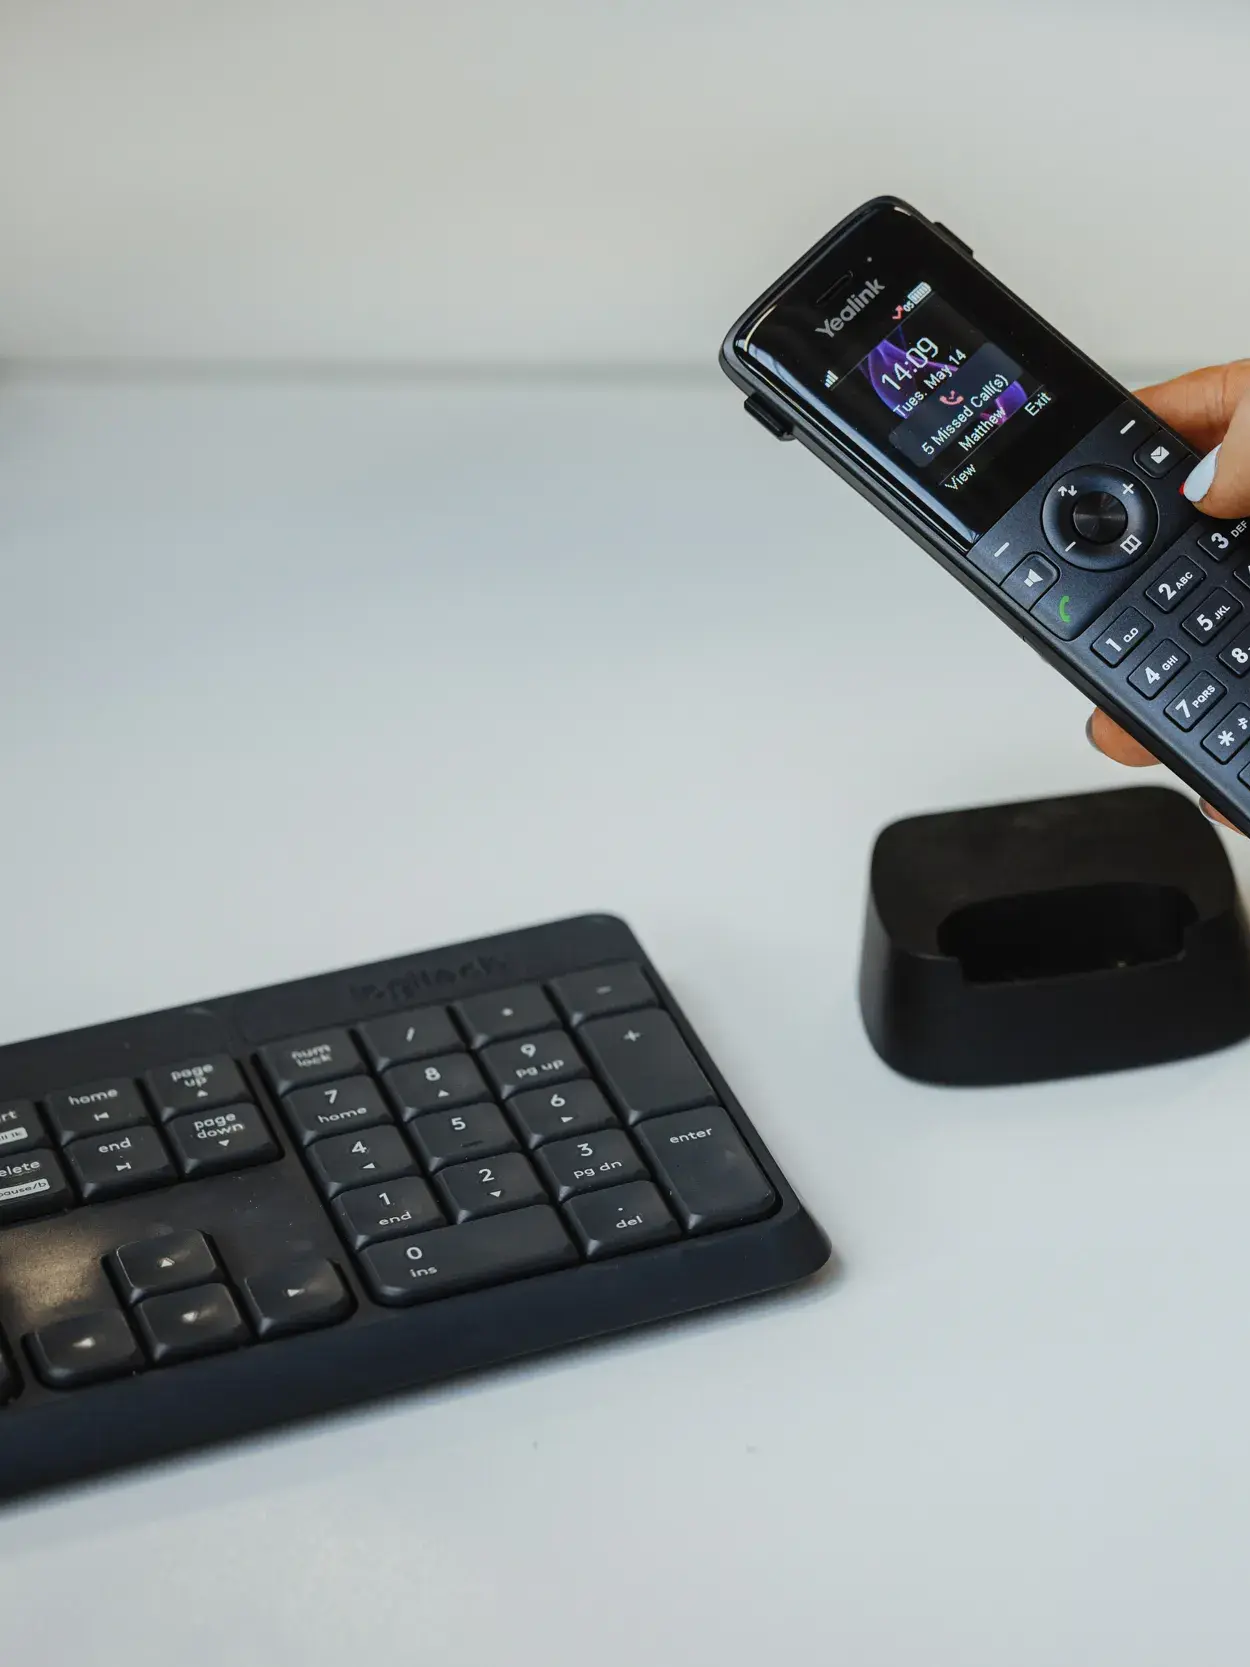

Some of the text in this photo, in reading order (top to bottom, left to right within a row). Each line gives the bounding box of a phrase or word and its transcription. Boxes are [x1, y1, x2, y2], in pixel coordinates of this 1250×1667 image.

[815, 278, 885, 338] Yealink
[881, 337, 939, 391] 14:09
[892, 348, 967, 419] Tues. May 14
[921, 373, 1010, 456] 5 Missed Call(s)
[958, 406, 1007, 451] Matthew
[945, 391, 1052, 491] View Exit
[1211, 520, 1249, 550] 3 DEF
[1158, 571, 1193, 600] 2 ABC
[1196, 605, 1231, 631] 5 JKL
[1105, 637, 1122, 652] 1
[1231, 647, 1248, 664] 8
[1144, 654, 1179, 684] 4 GHI
[1174, 684, 1216, 719] 7 PQRS
[291, 1044, 331, 1060] num
[520, 1043, 536, 1057] 9
[295, 1054, 333, 1068] lock
[515, 1059, 564, 1079] pg up
[170, 1063, 214, 1083] page
[424, 1066, 441, 1081] 8
[184, 1075, 208, 1089] up
[68, 1089, 118, 1106] home
[324, 1089, 338, 1104] 7
[550, 1093, 566, 1107] 6
[194, 1113, 237, 1131] page
[317, 1107, 367, 1123] home
[196, 1122, 245, 1139] down
[451, 1117, 466, 1131] 5
[669, 1127, 713, 1144] enter
[98, 1136, 132, 1153] end
[351, 1140, 368, 1153] 4
[577, 1142, 593, 1157] 3
[478, 1168, 495, 1182] 2
[573, 1160, 623, 1179] pg dn
[378, 1192, 391, 1205] 1
[378, 1210, 412, 1226] end
[615, 1215, 643, 1229] del
[406, 1246, 423, 1260] 0
[409, 1266, 438, 1278] ins
